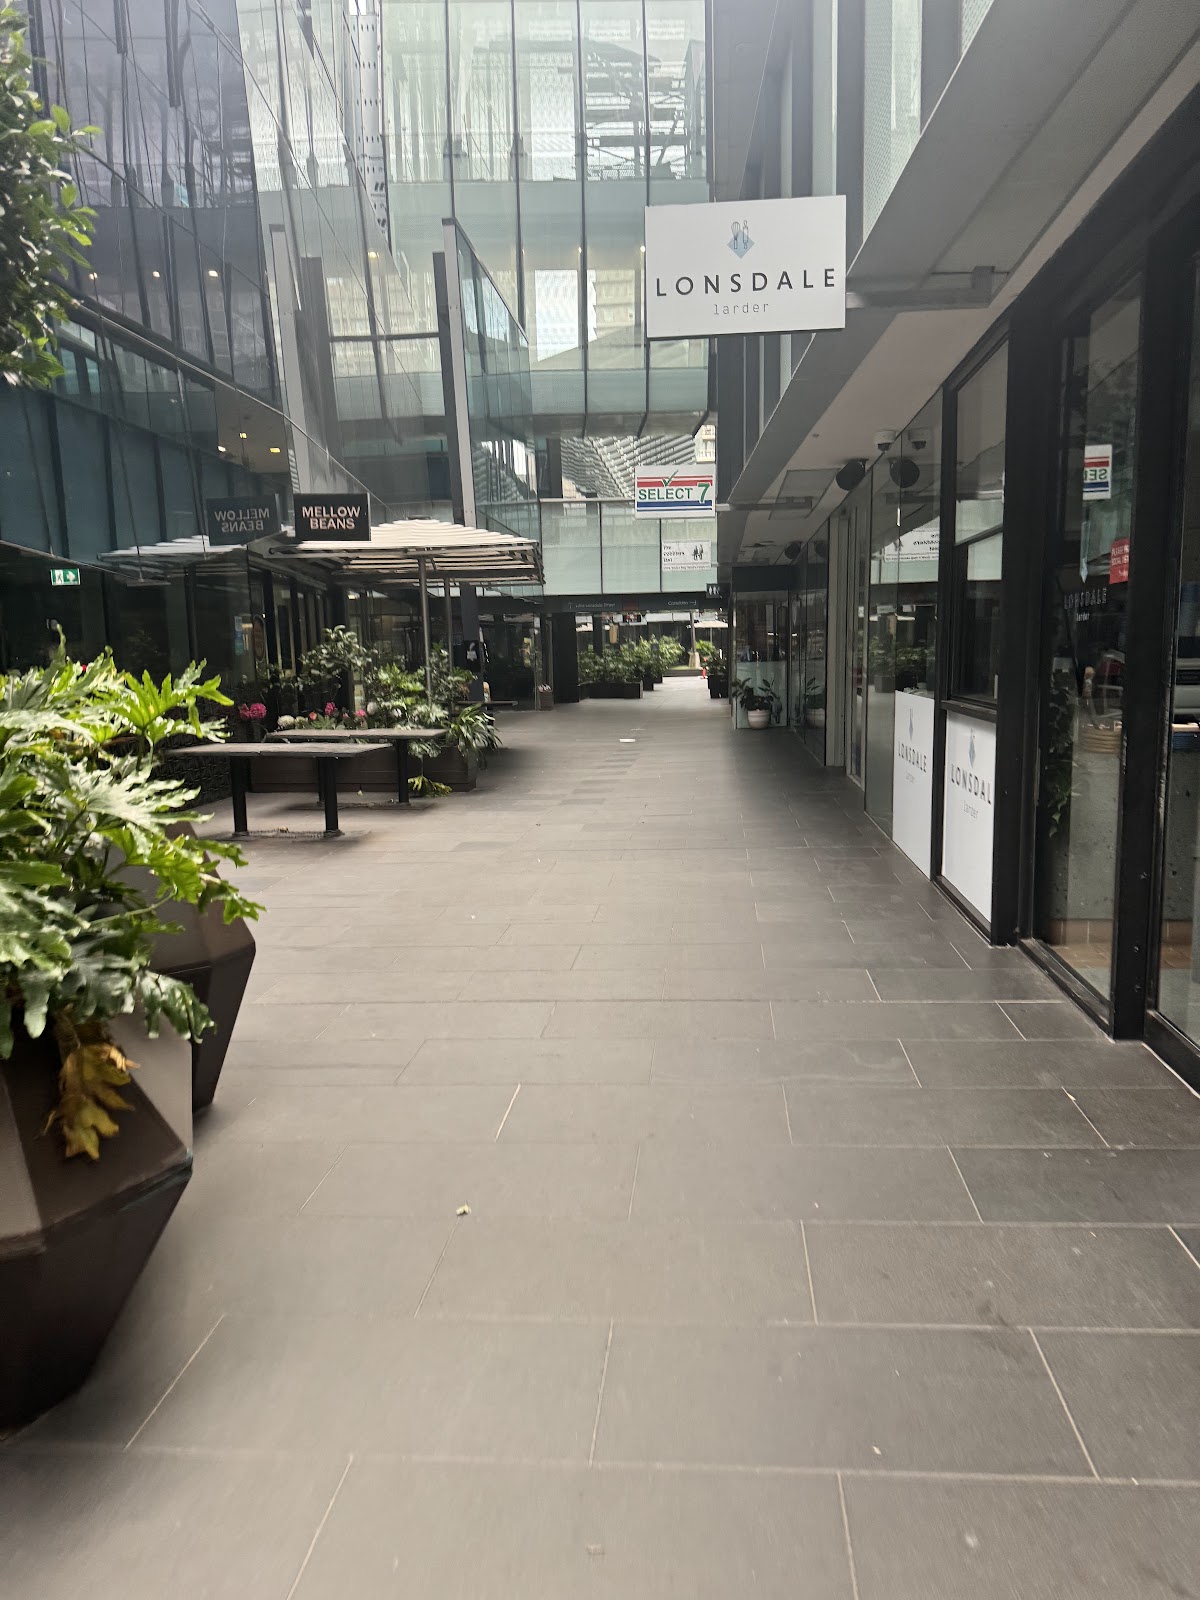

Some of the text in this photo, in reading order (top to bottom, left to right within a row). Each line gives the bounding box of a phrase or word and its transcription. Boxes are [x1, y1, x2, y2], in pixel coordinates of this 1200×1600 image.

[656, 268, 835, 297] LONSDALE
[713, 302, 769, 316] larder
[638, 482, 711, 503] SELECT 7
[302, 506, 361, 518] MELLOW
[310, 517, 355, 530] BEANS
[1064, 587, 1107, 610] LONSDALE
[898, 740, 927, 773] LONSDALE
[951, 763, 992, 805] LONSDAL
